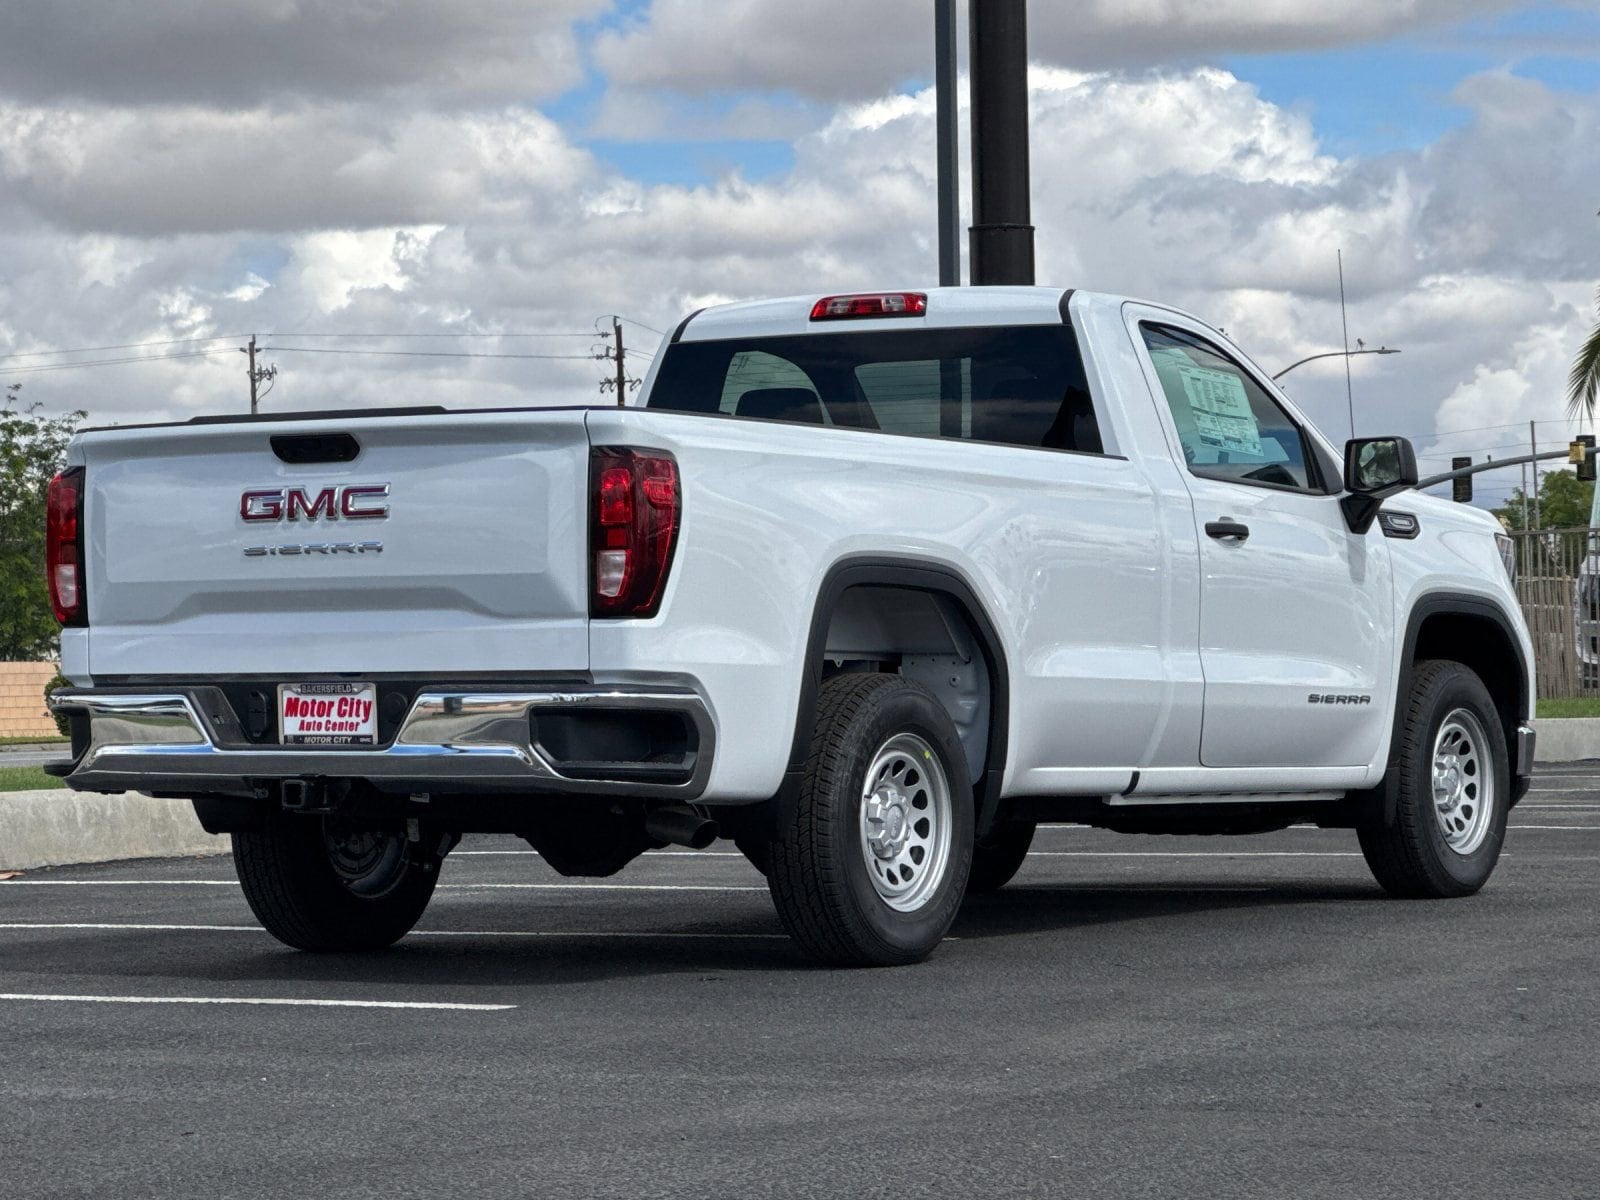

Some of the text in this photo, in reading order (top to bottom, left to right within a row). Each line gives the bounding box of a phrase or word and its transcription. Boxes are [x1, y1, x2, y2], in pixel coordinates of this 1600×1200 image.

[240, 483, 391, 521] GMC
[243, 541, 383, 556] SIERRA
[301, 684, 352, 694] BAKERSFIELD
[1308, 693, 1371, 705] SIERRA
[285, 697, 372, 724] Motor City
[298, 719, 360, 732] Auto Center
[303, 736, 331, 744] MOTOR
[333, 736, 353, 744] CITY
